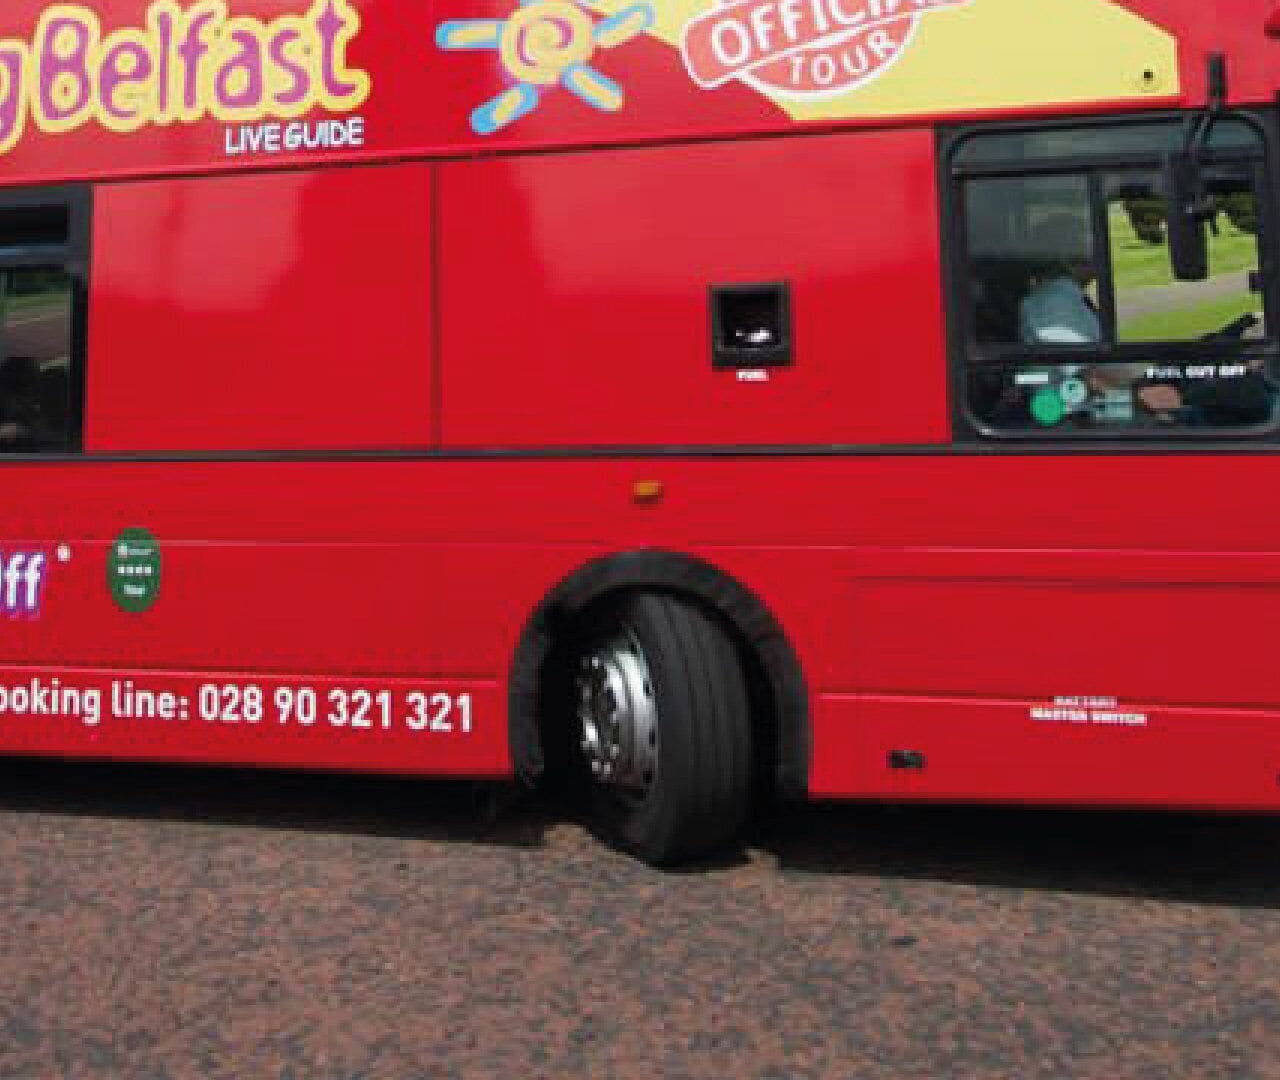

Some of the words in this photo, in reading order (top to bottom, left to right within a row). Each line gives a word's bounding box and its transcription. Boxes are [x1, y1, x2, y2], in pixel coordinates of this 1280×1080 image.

[788, 29, 898, 86] TOUR
[225, 124, 281, 155] LIVE
[284, 116, 365, 149] GUIDE
[111, 680, 189, 720] line:
[198, 683, 263, 722] 028
[274, 686, 317, 724] 90
[327, 688, 392, 729] 321
[405, 692, 473, 733] 321
